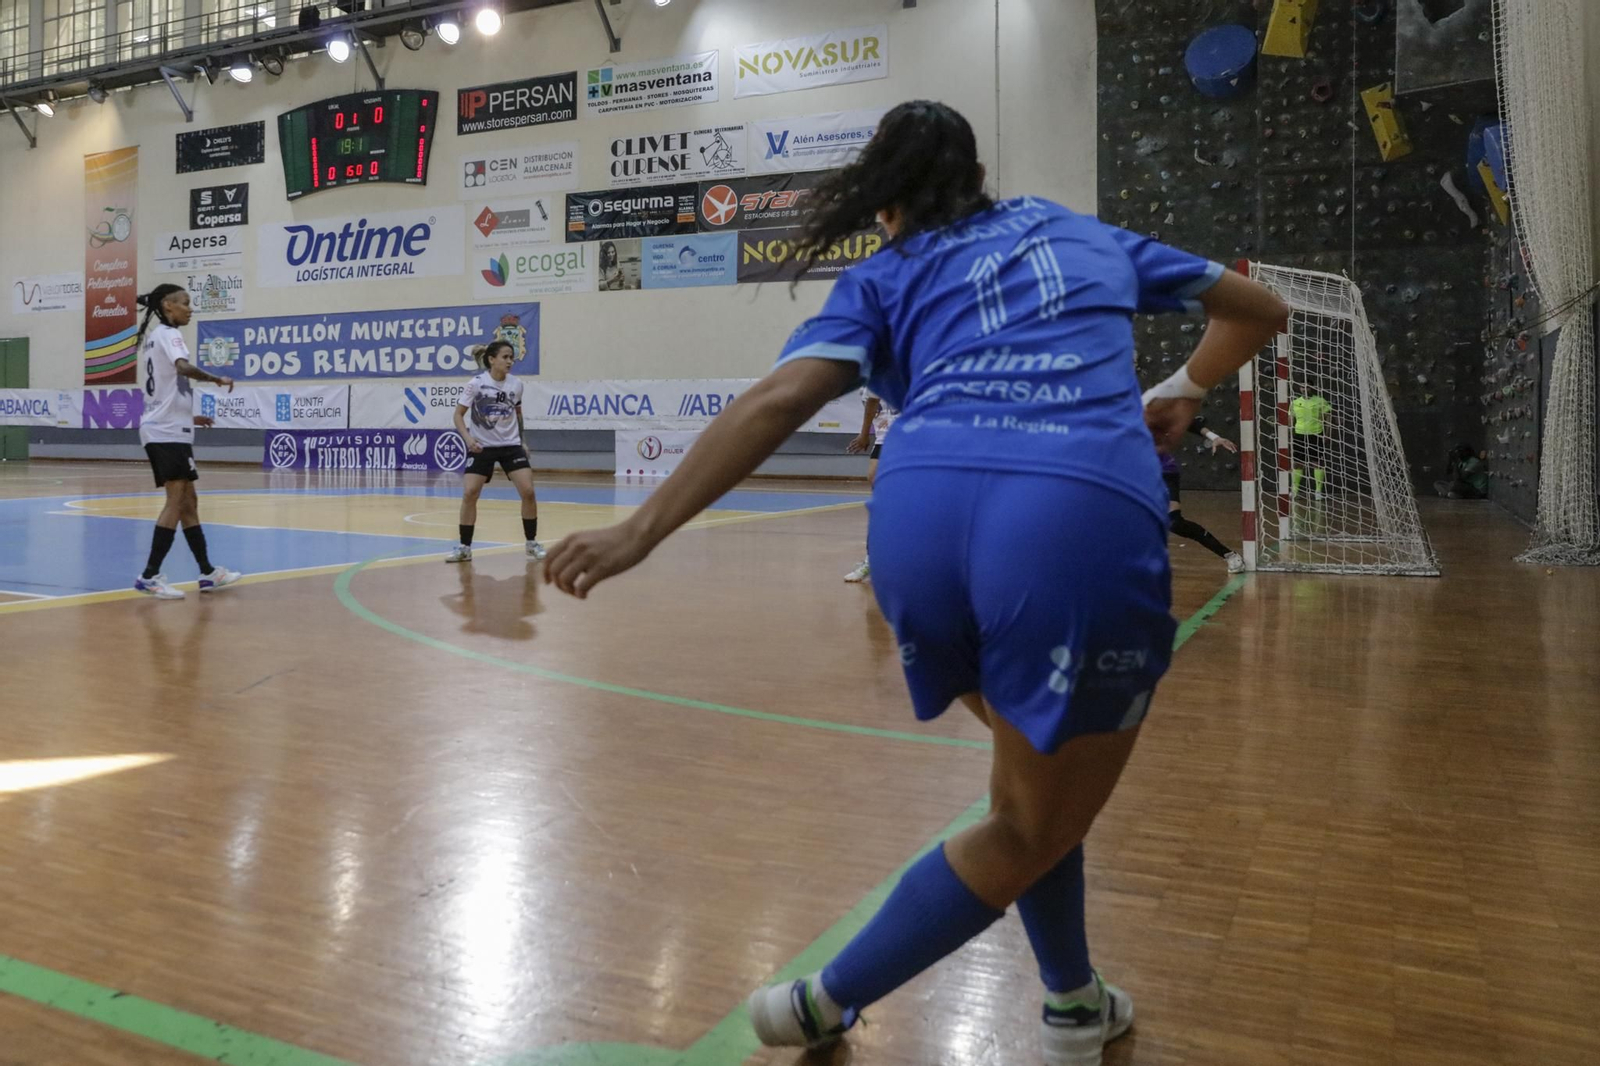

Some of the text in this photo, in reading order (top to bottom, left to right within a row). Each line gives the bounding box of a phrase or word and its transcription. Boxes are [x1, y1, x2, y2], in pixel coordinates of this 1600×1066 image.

[739, 36, 880, 79] NOVASUR
[615, 61, 704, 80] www.masventana.es
[800, 67, 838, 78] Suministros
[614, 71, 712, 94] masventana
[489, 80, 574, 114] PERSAN
[612, 96, 643, 104] PERSIANAS
[647, 92, 669, 100] STORES
[673, 85, 714, 96] MOSQUITERAS
[335, 112, 344, 129] 0
[374, 106, 383, 123] 0
[462, 107, 572, 133] www.storespersan.com
[610, 132, 692, 157] CLIVET
[793, 135, 814, 145] Alén
[328, 161, 378, 180] 0 60 0
[489, 158, 518, 171] CEN
[524, 161, 572, 174] ALMACENAJE
[610, 153, 692, 178] OURENSE
[603, 196, 674, 214] segurma
[197, 213, 242, 227] Copersa
[626, 220, 642, 228] Hogar
[646, 218, 670, 227] Negocio
[744, 211, 781, 220] ESTACIONES
[168, 234, 227, 254] Apersa
[283, 218, 432, 267] Ontime
[516, 244, 585, 278] ecogal
[698, 254, 725, 263] centro
[296, 261, 415, 283] LOGÍSTICA INTEGRAL
[187, 275, 202, 292] La
[965, 235, 1066, 338] 11
[104, 293, 116, 304] dos
[92, 303, 129, 318] Remedios
[244, 315, 484, 346] PAVILLÓN MUNICIPAL
[244, 344, 480, 377] DOS REMEDIOS
[145, 357, 156, 396] 8
[293, 397, 324, 407] XUNTA
[217, 409, 228, 418] DE
[293, 407, 342, 418] DE GALICIA
[973, 414, 998, 429] La
[318, 432, 396, 445] DIVISIÓN
[318, 444, 396, 469] FÚTBOL SALA
